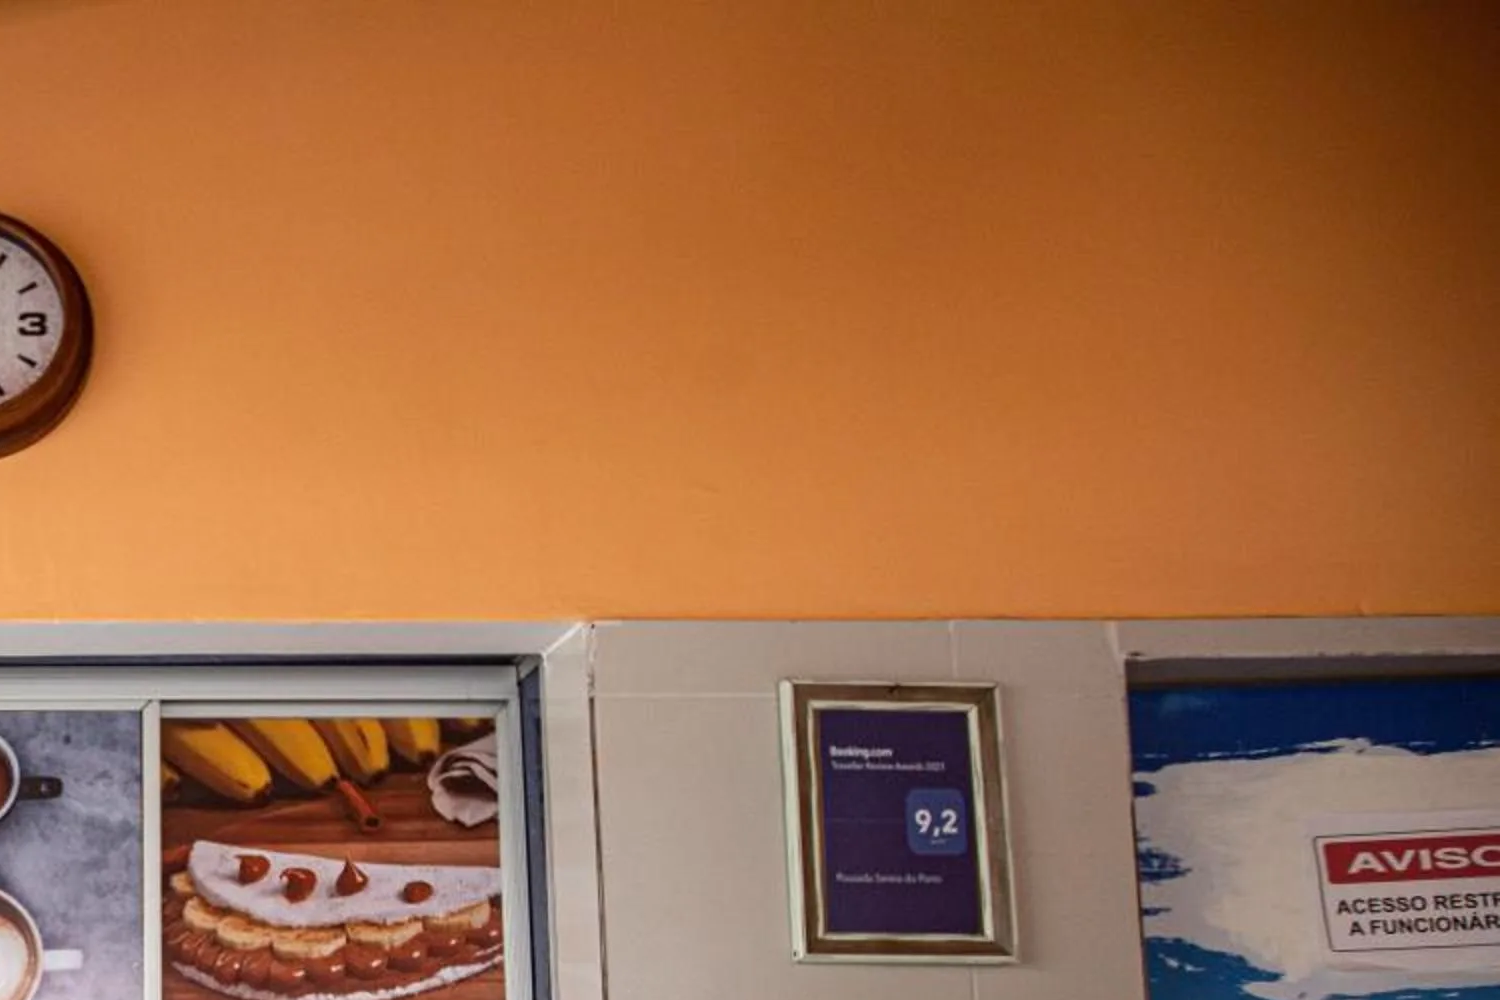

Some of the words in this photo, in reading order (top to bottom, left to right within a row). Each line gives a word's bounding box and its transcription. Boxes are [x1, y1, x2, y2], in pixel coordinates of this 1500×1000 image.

[17, 312, 47, 336] 3
[915, 809, 959, 838] 9,2
[1347, 845, 1500, 874] AVISO
[1337, 895, 1427, 915] ACESSO
[1349, 921, 1365, 937] A
[1369, 911, 1500, 936] FUNCIONÁR
